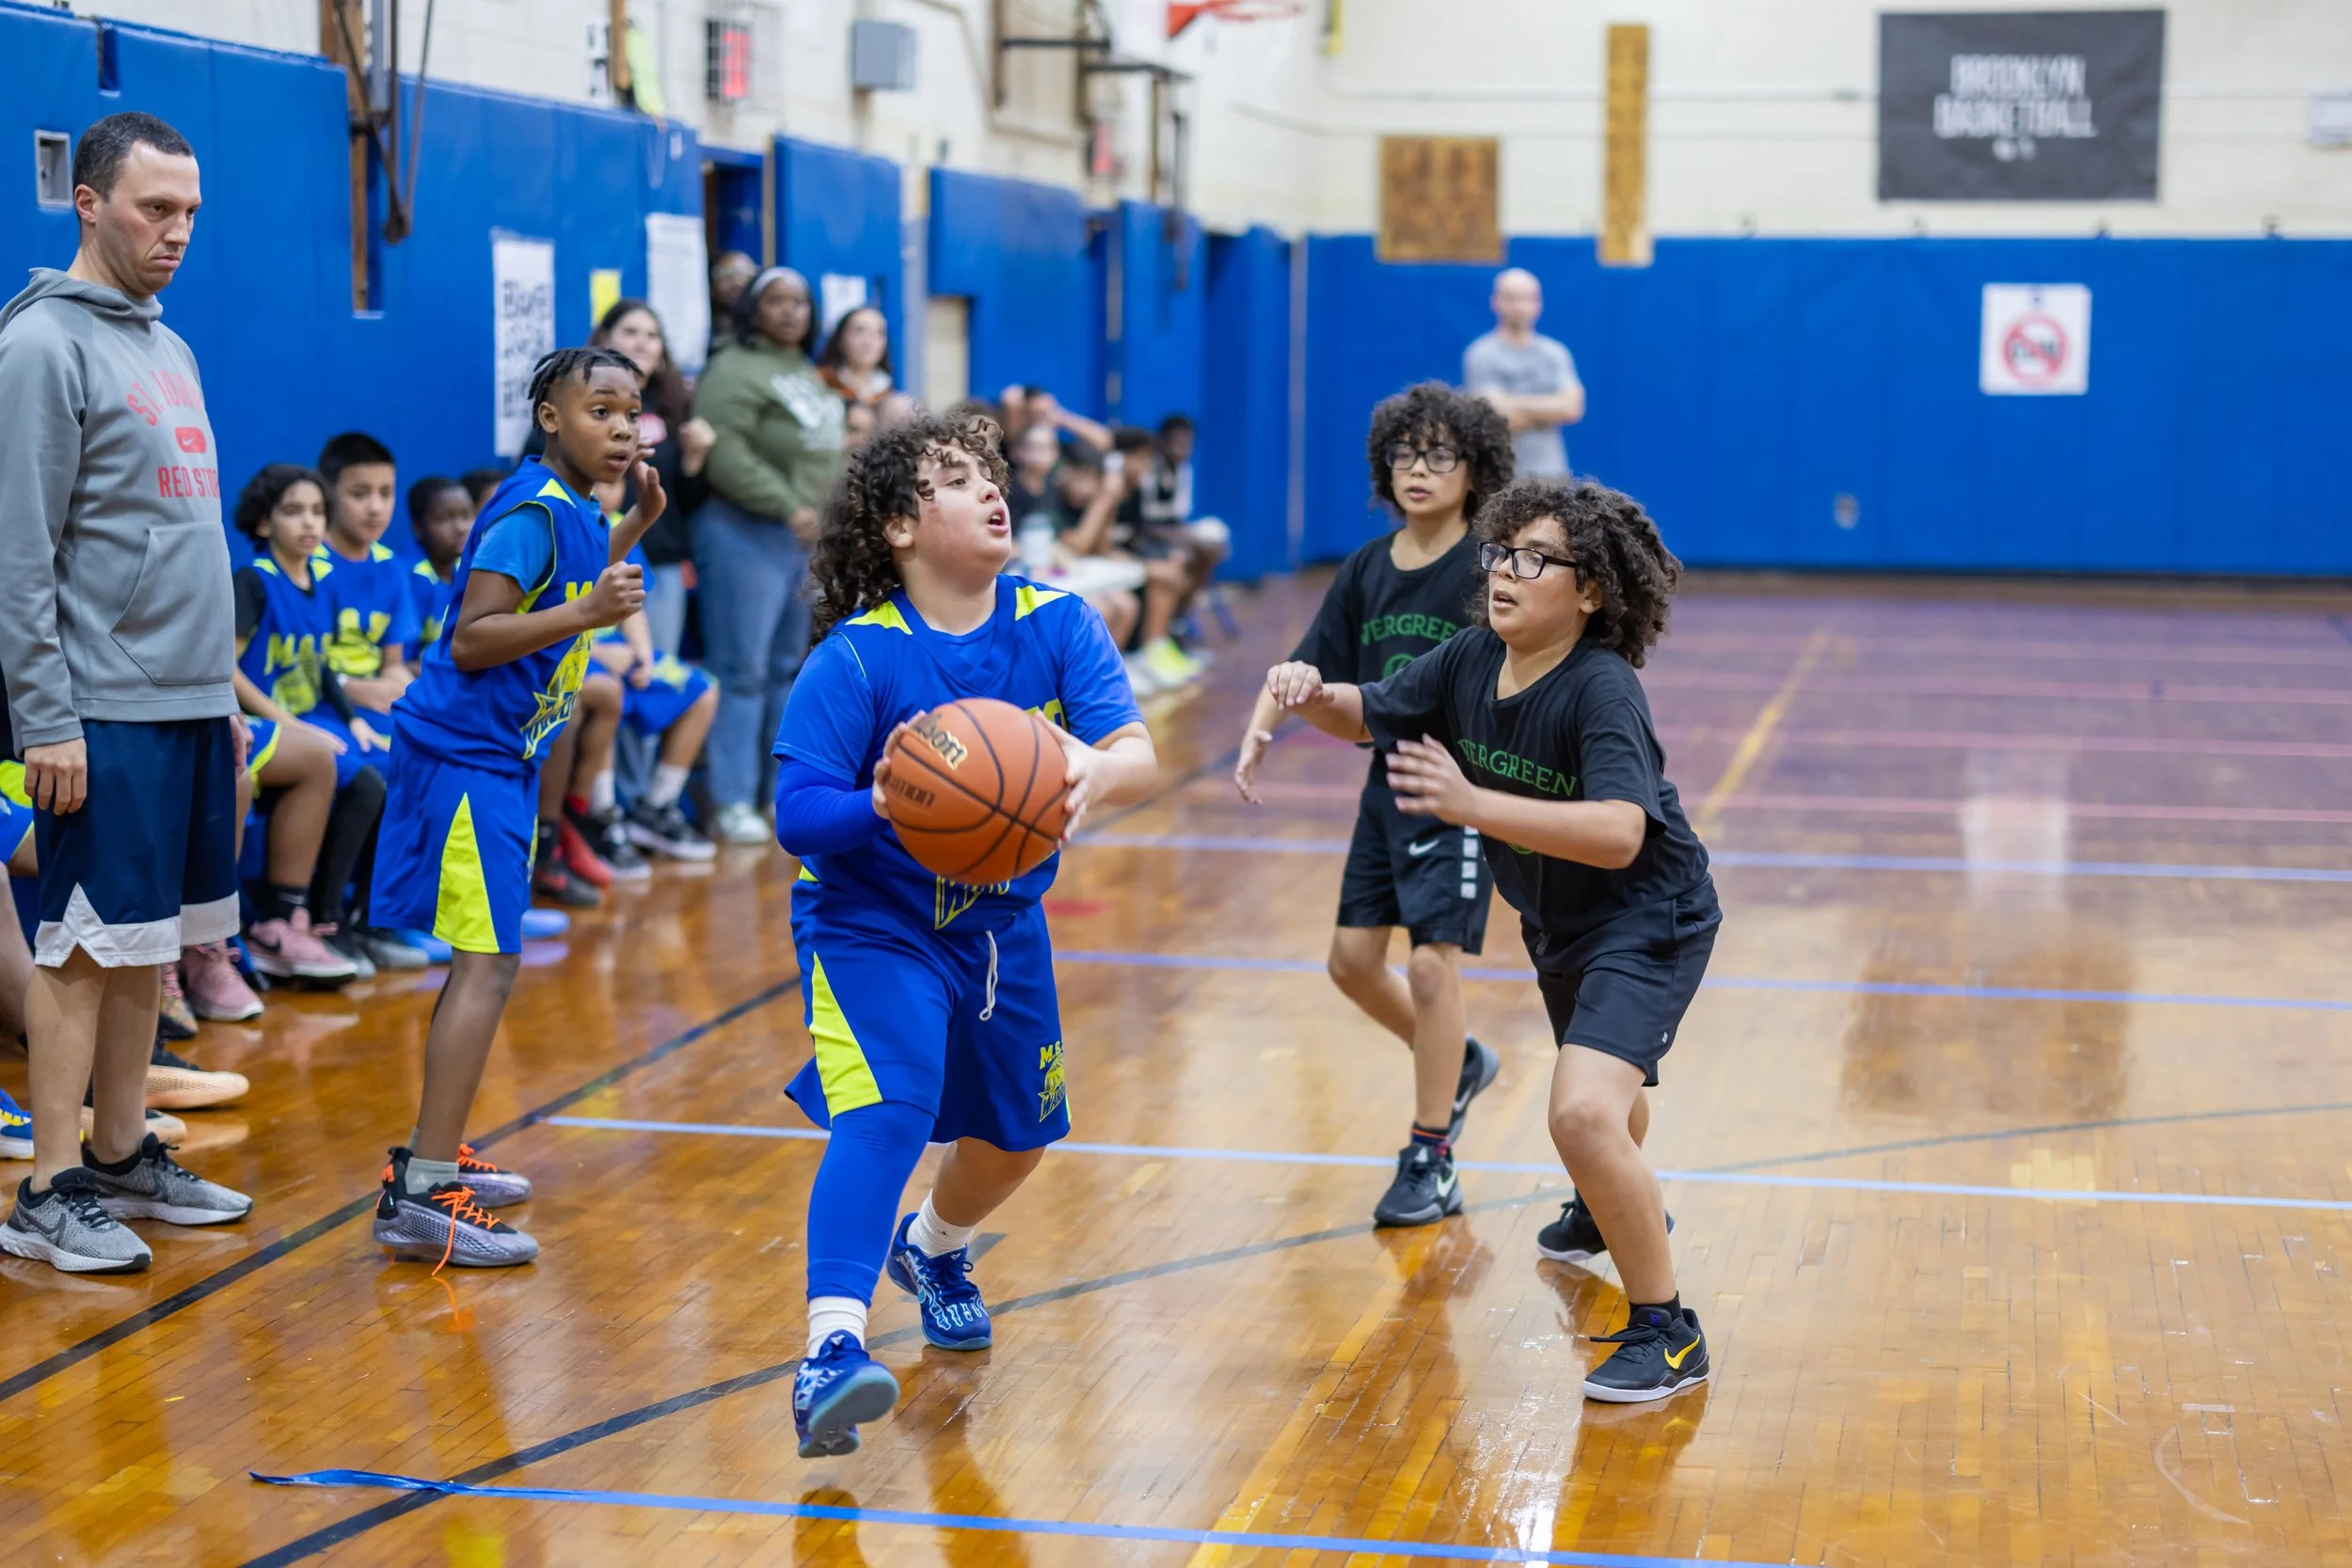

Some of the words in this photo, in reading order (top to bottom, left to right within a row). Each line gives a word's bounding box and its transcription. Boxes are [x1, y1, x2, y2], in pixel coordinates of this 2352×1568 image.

[1932, 93, 2099, 138] BASKETBALL
[157, 467, 193, 498] RED
[1457, 738, 1578, 798] VERGREEN
